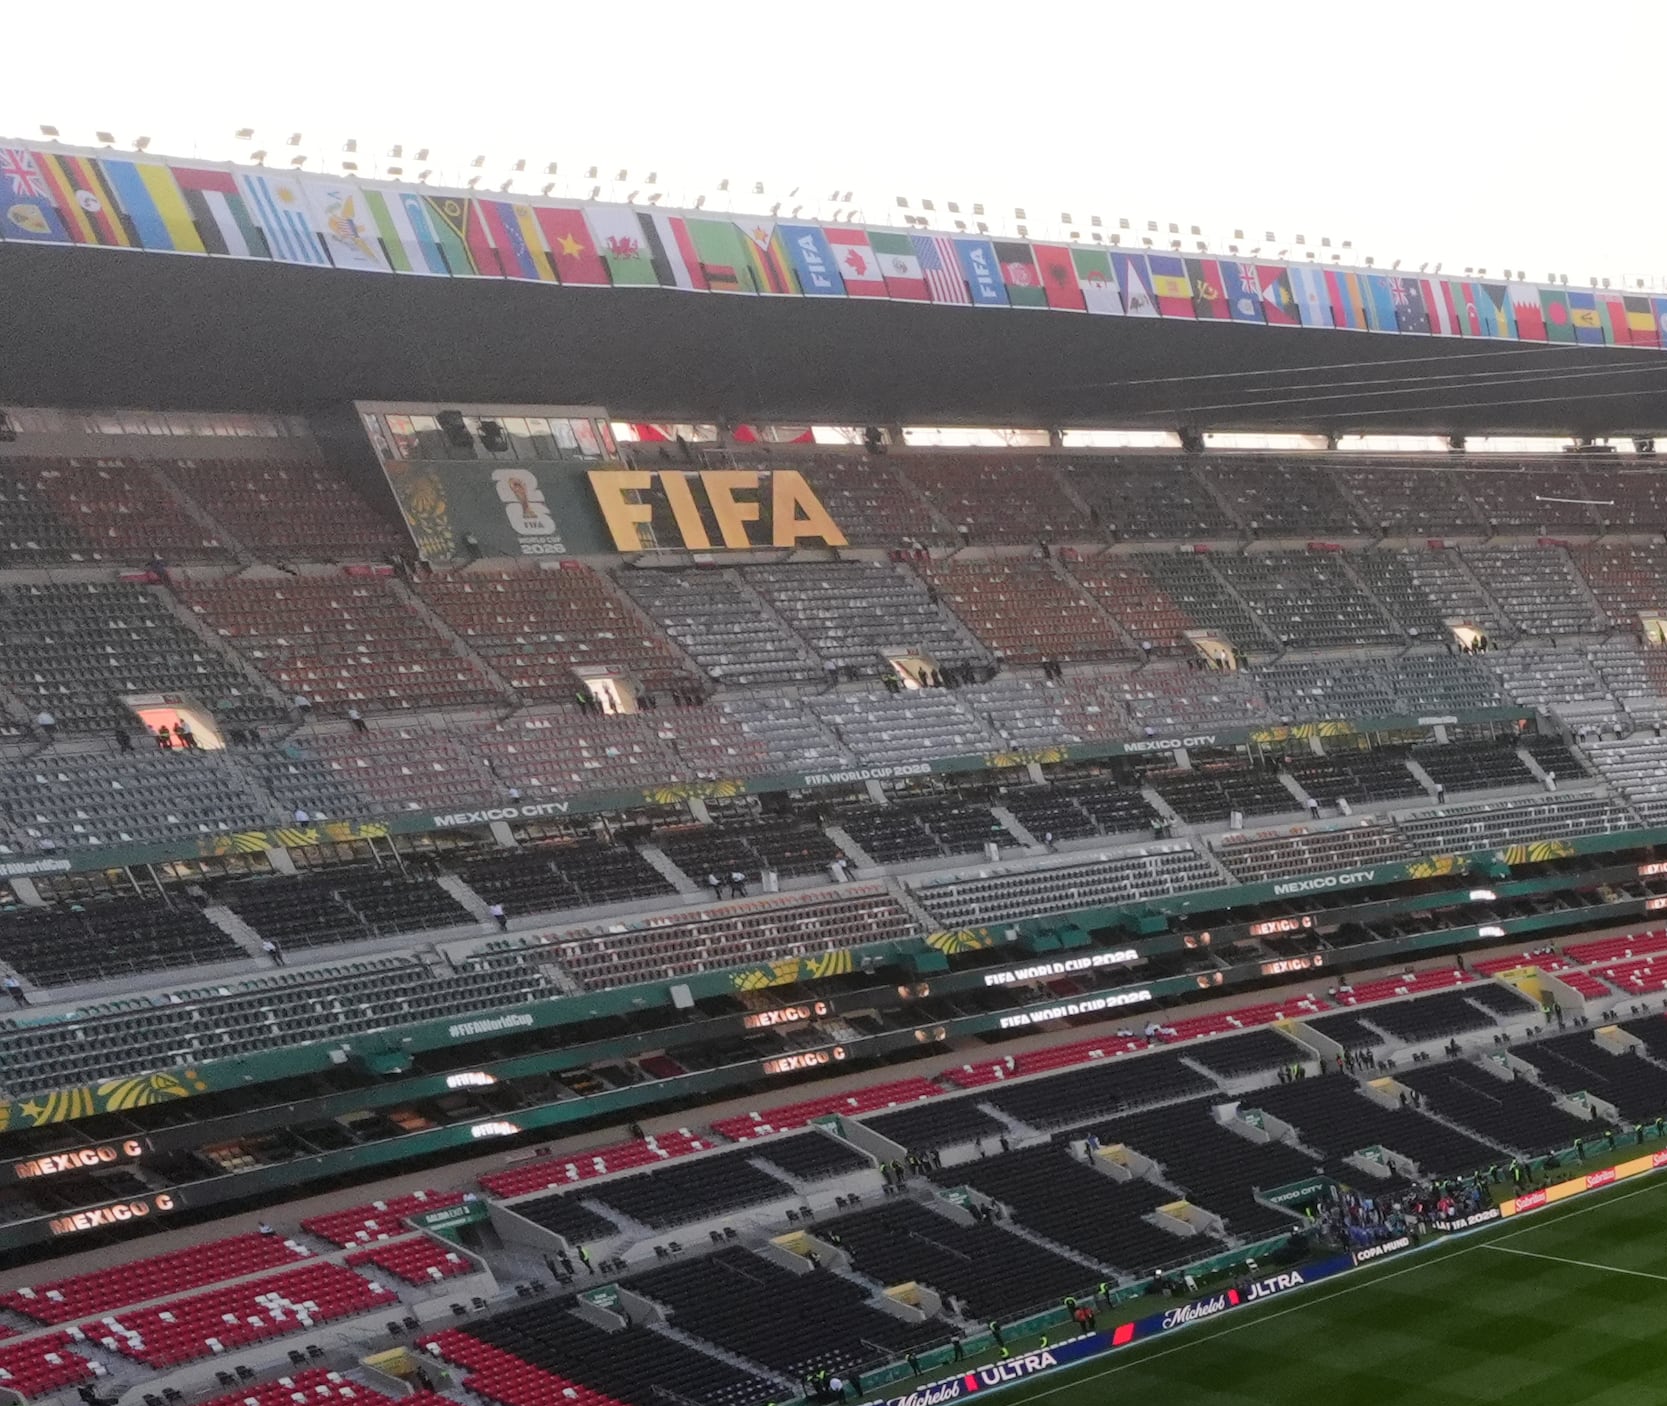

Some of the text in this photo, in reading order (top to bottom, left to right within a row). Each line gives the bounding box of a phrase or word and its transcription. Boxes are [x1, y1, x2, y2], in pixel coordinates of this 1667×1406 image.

[798, 234, 832, 287] FIFA
[970, 247, 996, 298] FIFA
[587, 470, 849, 551] FIFA
[520, 544, 566, 554] 2026
[1124, 735, 1216, 753] MEXICO CITY
[805, 763, 931, 786] FIFA WORLD CUP 2026
[433, 801, 569, 828] MEXICO CITY
[1274, 870, 1375, 895] MEXICO CITY
[984, 949, 1139, 987] FIFA WORLD CUP 2026
[744, 1005, 812, 1029] MEXICO
[1000, 991, 1151, 1029] FIFA WORLD CUP 2026
[448, 1013, 534, 1038] #FIFAWorldCup
[764, 1050, 829, 1074] MEXICO
[15, 1146, 117, 1179] MEXICO
[1300, 1185, 1322, 1197] CITY
[1587, 1168, 1615, 1188] Sabritas
[1516, 1191, 1546, 1212] Sabritas
[50, 1201, 150, 1235] MEXICO
[1357, 1243, 1383, 1261] COPA
[1382, 1237, 1409, 1252] MUND
[1468, 1208, 1499, 1224] 2026
[1163, 1294, 1225, 1329] Michelob
[981, 1352, 1057, 1386] ULTRA
